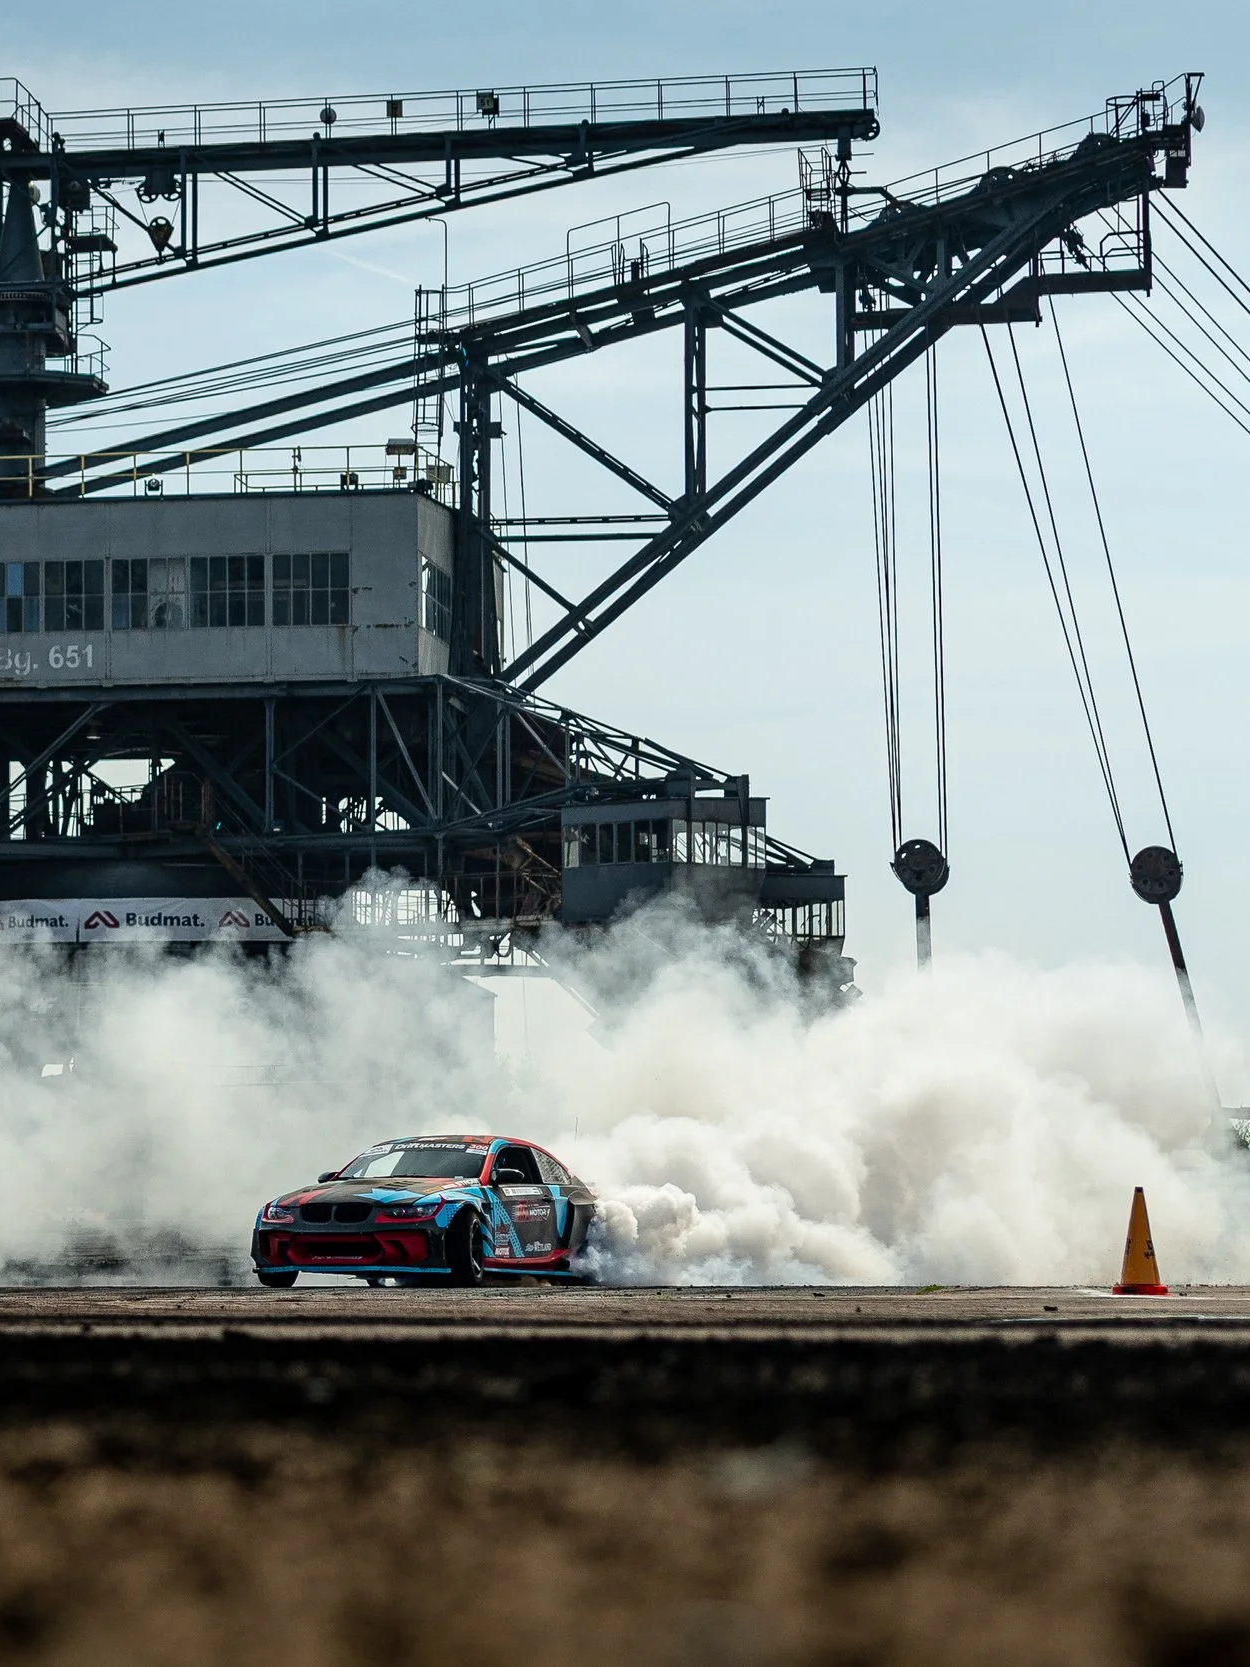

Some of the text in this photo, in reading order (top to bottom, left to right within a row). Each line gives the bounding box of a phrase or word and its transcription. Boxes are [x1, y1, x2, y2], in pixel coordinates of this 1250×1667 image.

[49, 644, 93, 668] 651
[8, 915, 69, 929] Budmat.
[126, 912, 205, 927] Budmat.
